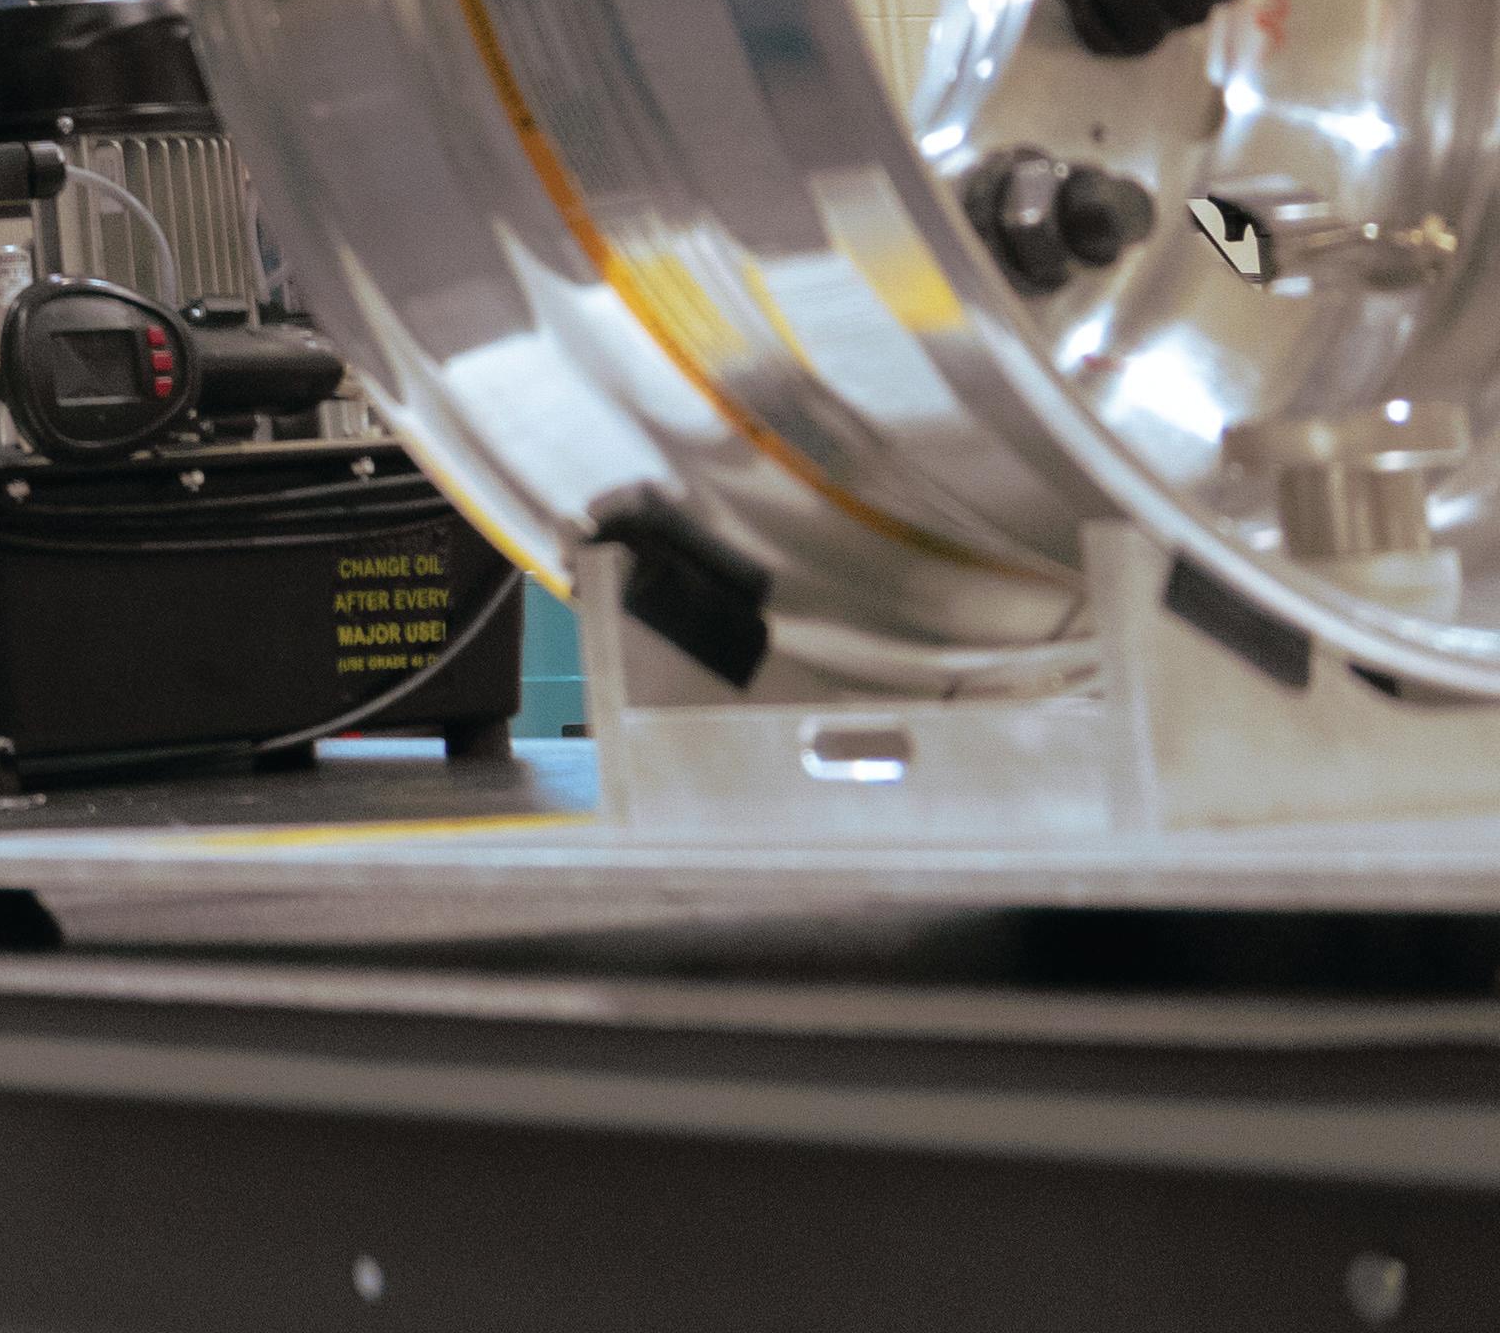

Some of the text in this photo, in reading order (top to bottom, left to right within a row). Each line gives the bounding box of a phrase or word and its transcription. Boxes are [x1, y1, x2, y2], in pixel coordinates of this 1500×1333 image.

[339, 554, 445, 579] CHANGE OIL
[333, 587, 450, 613] AFTER EVERY
[336, 621, 402, 646] MAJOR
